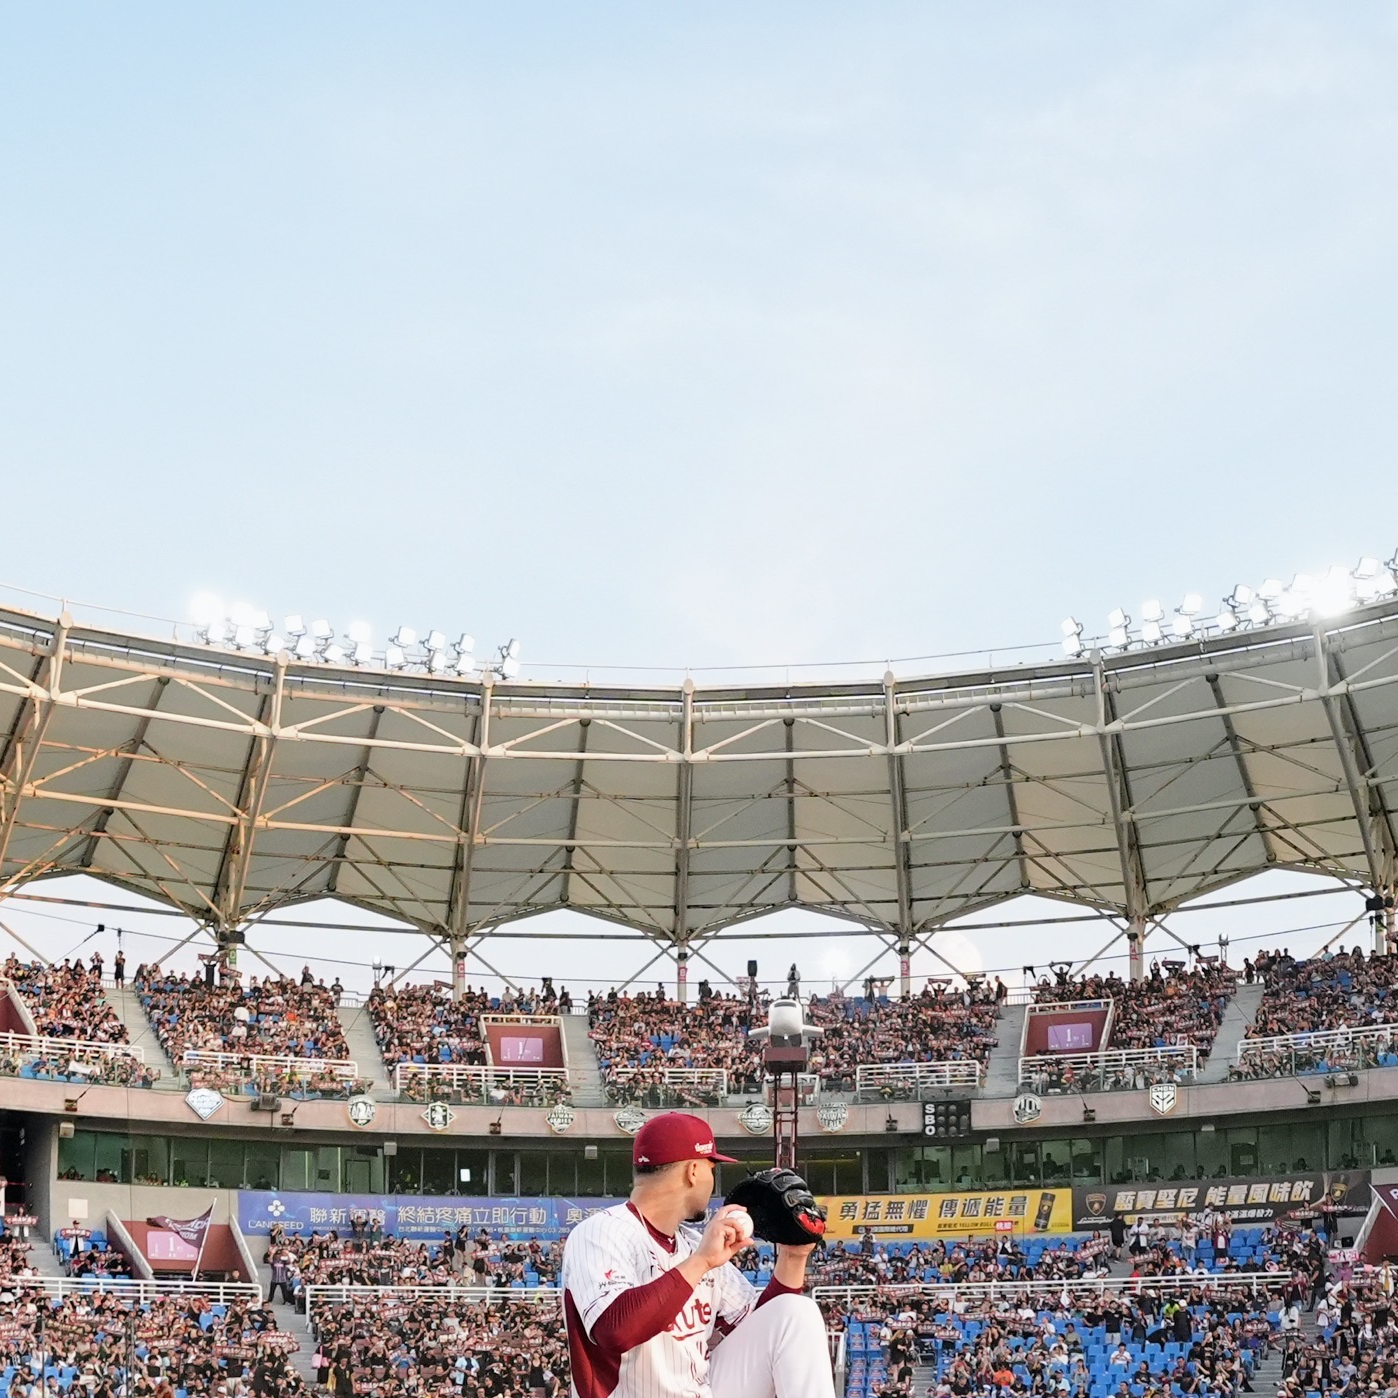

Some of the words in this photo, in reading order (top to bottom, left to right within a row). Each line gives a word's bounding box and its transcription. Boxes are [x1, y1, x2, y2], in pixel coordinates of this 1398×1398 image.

[925, 1103, 935, 1114] S
[925, 1114, 936, 1125] B
[1113, 1188, 1199, 1211] 藍寶堅尼
[1205, 1181, 1314, 1206] 能量風味飲
[839, 1199, 931, 1221] 勇猛無懼
[938, 1196, 1029, 1219] 傳遞能量
